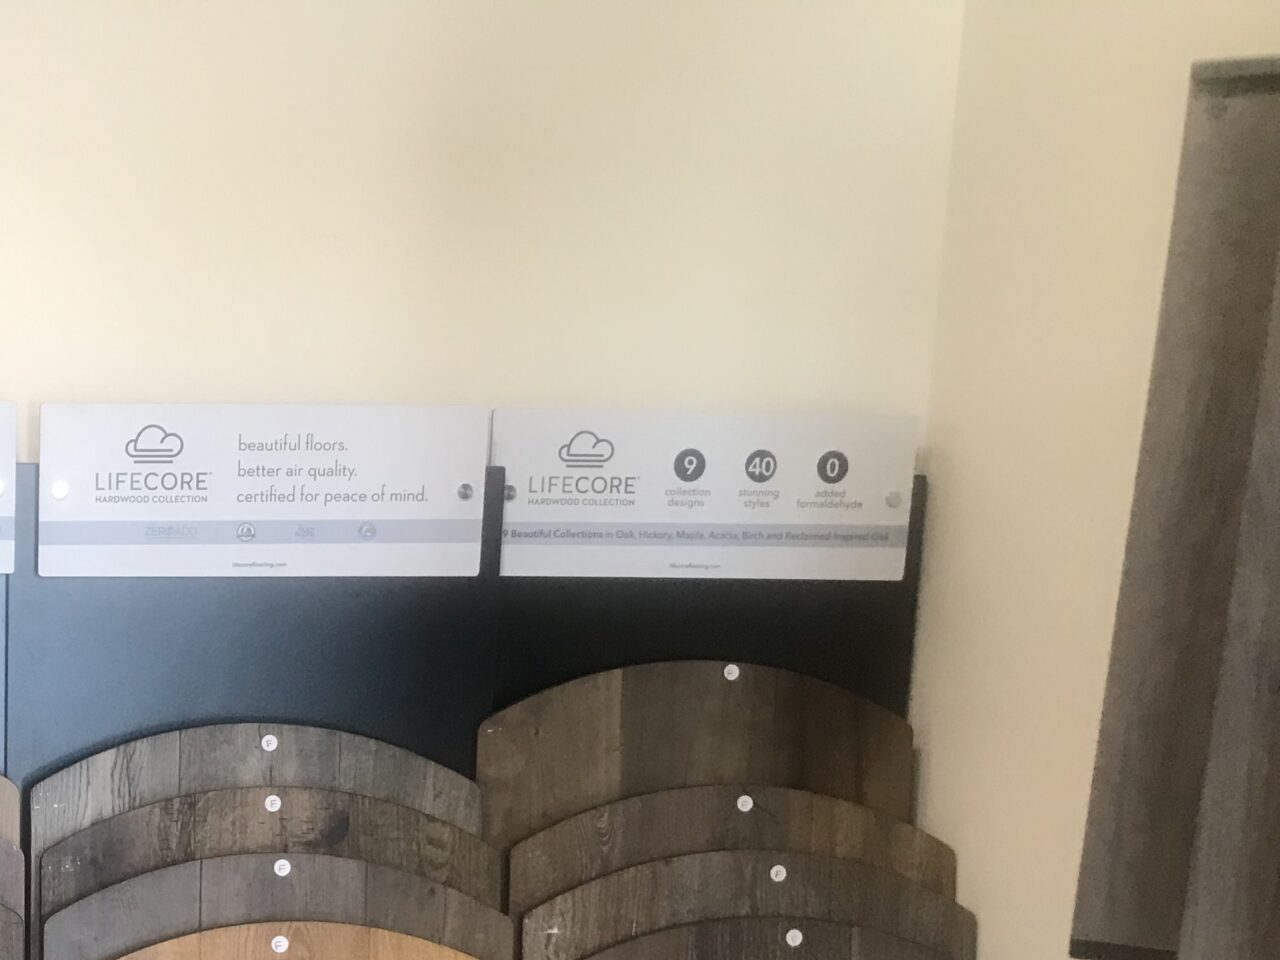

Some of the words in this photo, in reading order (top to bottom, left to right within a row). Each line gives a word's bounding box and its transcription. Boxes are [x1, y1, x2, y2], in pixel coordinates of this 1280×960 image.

[238, 433, 301, 452] beautiful
[305, 433, 349, 452] floors.
[237, 460, 282, 477] better
[285, 465, 303, 477] air
[308, 459, 357, 481] quality.
[684, 456, 697, 475] 9
[748, 457, 775, 476] 40
[826, 458, 839, 477] 0
[95, 472, 208, 491] LIFECORE
[528, 476, 636, 494] LIFECORE
[236, 485, 296, 503] certified
[300, 485, 320, 503] for
[324, 490, 367, 506] peace
[371, 484, 386, 502] of
[390, 485, 428, 502] mind.
[664, 488, 711, 497] collection
[738, 489, 780, 499] stunning
[815, 490, 846, 498] added
[95, 495, 149, 503] HARDWOOD
[582, 498, 635, 506] COLLECTION
[667, 498, 704, 509] designs
[744, 499, 770, 509] styles
[797, 499, 863, 510] formaldehyde
[511, 529, 551, 538] Beautiful
[553, 530, 603, 538] Collections
